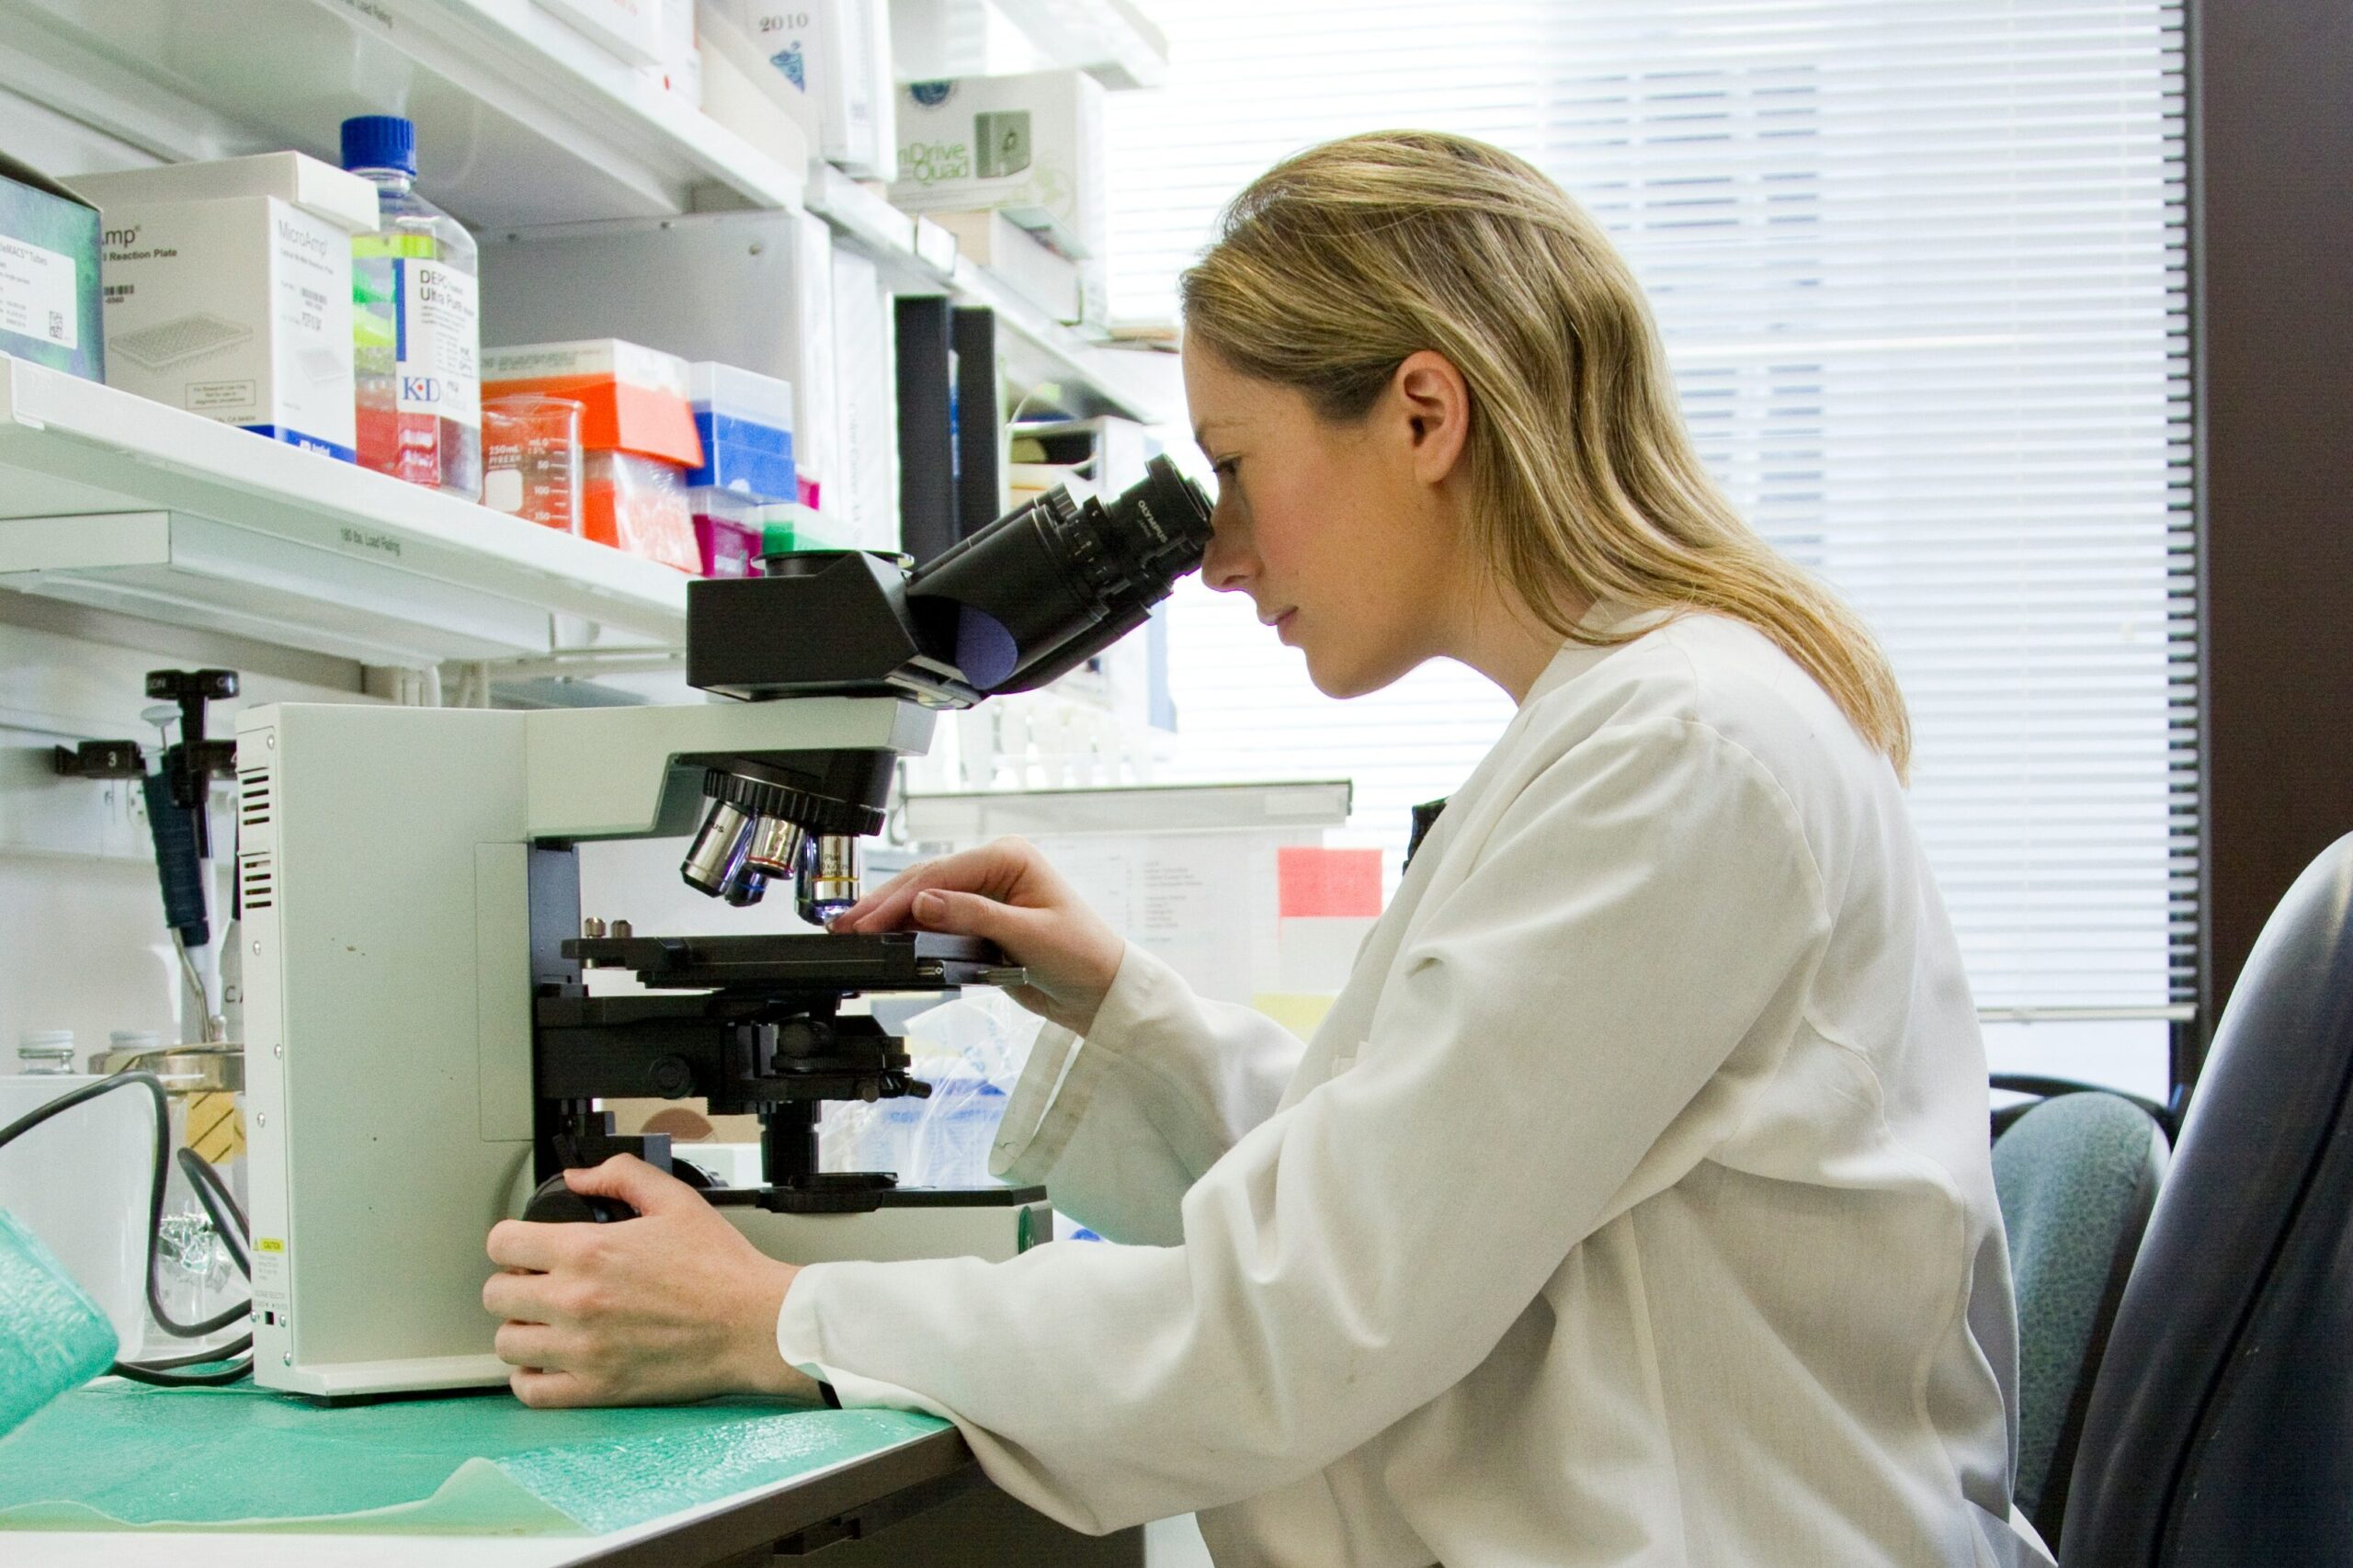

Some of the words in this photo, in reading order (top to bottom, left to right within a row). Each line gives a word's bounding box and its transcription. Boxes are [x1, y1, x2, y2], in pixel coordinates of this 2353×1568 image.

[759, 12, 809, 32] 2010
[109, 252, 152, 262] Reaction
[153, 249, 178, 258] Plate
[1138, 499, 1168, 544] OLYMPUS
[108, 752, 117, 767] 3
